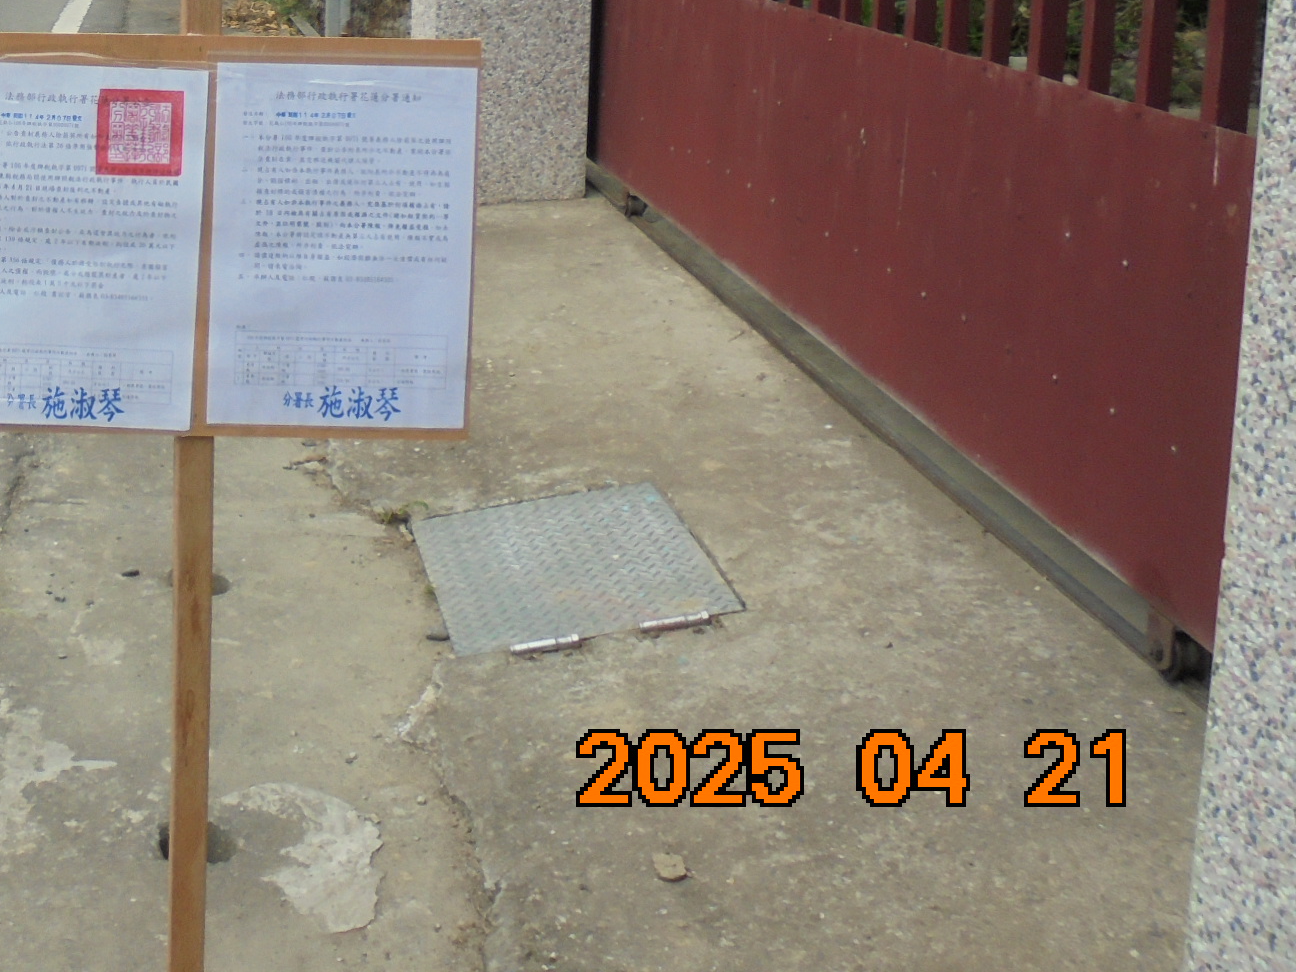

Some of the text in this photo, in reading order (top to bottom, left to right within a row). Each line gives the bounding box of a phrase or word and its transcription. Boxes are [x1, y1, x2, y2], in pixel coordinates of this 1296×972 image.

[5, 91, 151, 106] 法務部行政執行署花
[41, 386, 125, 423] 施淑琴
[282, 385, 402, 422] 分署長 施淑琴
